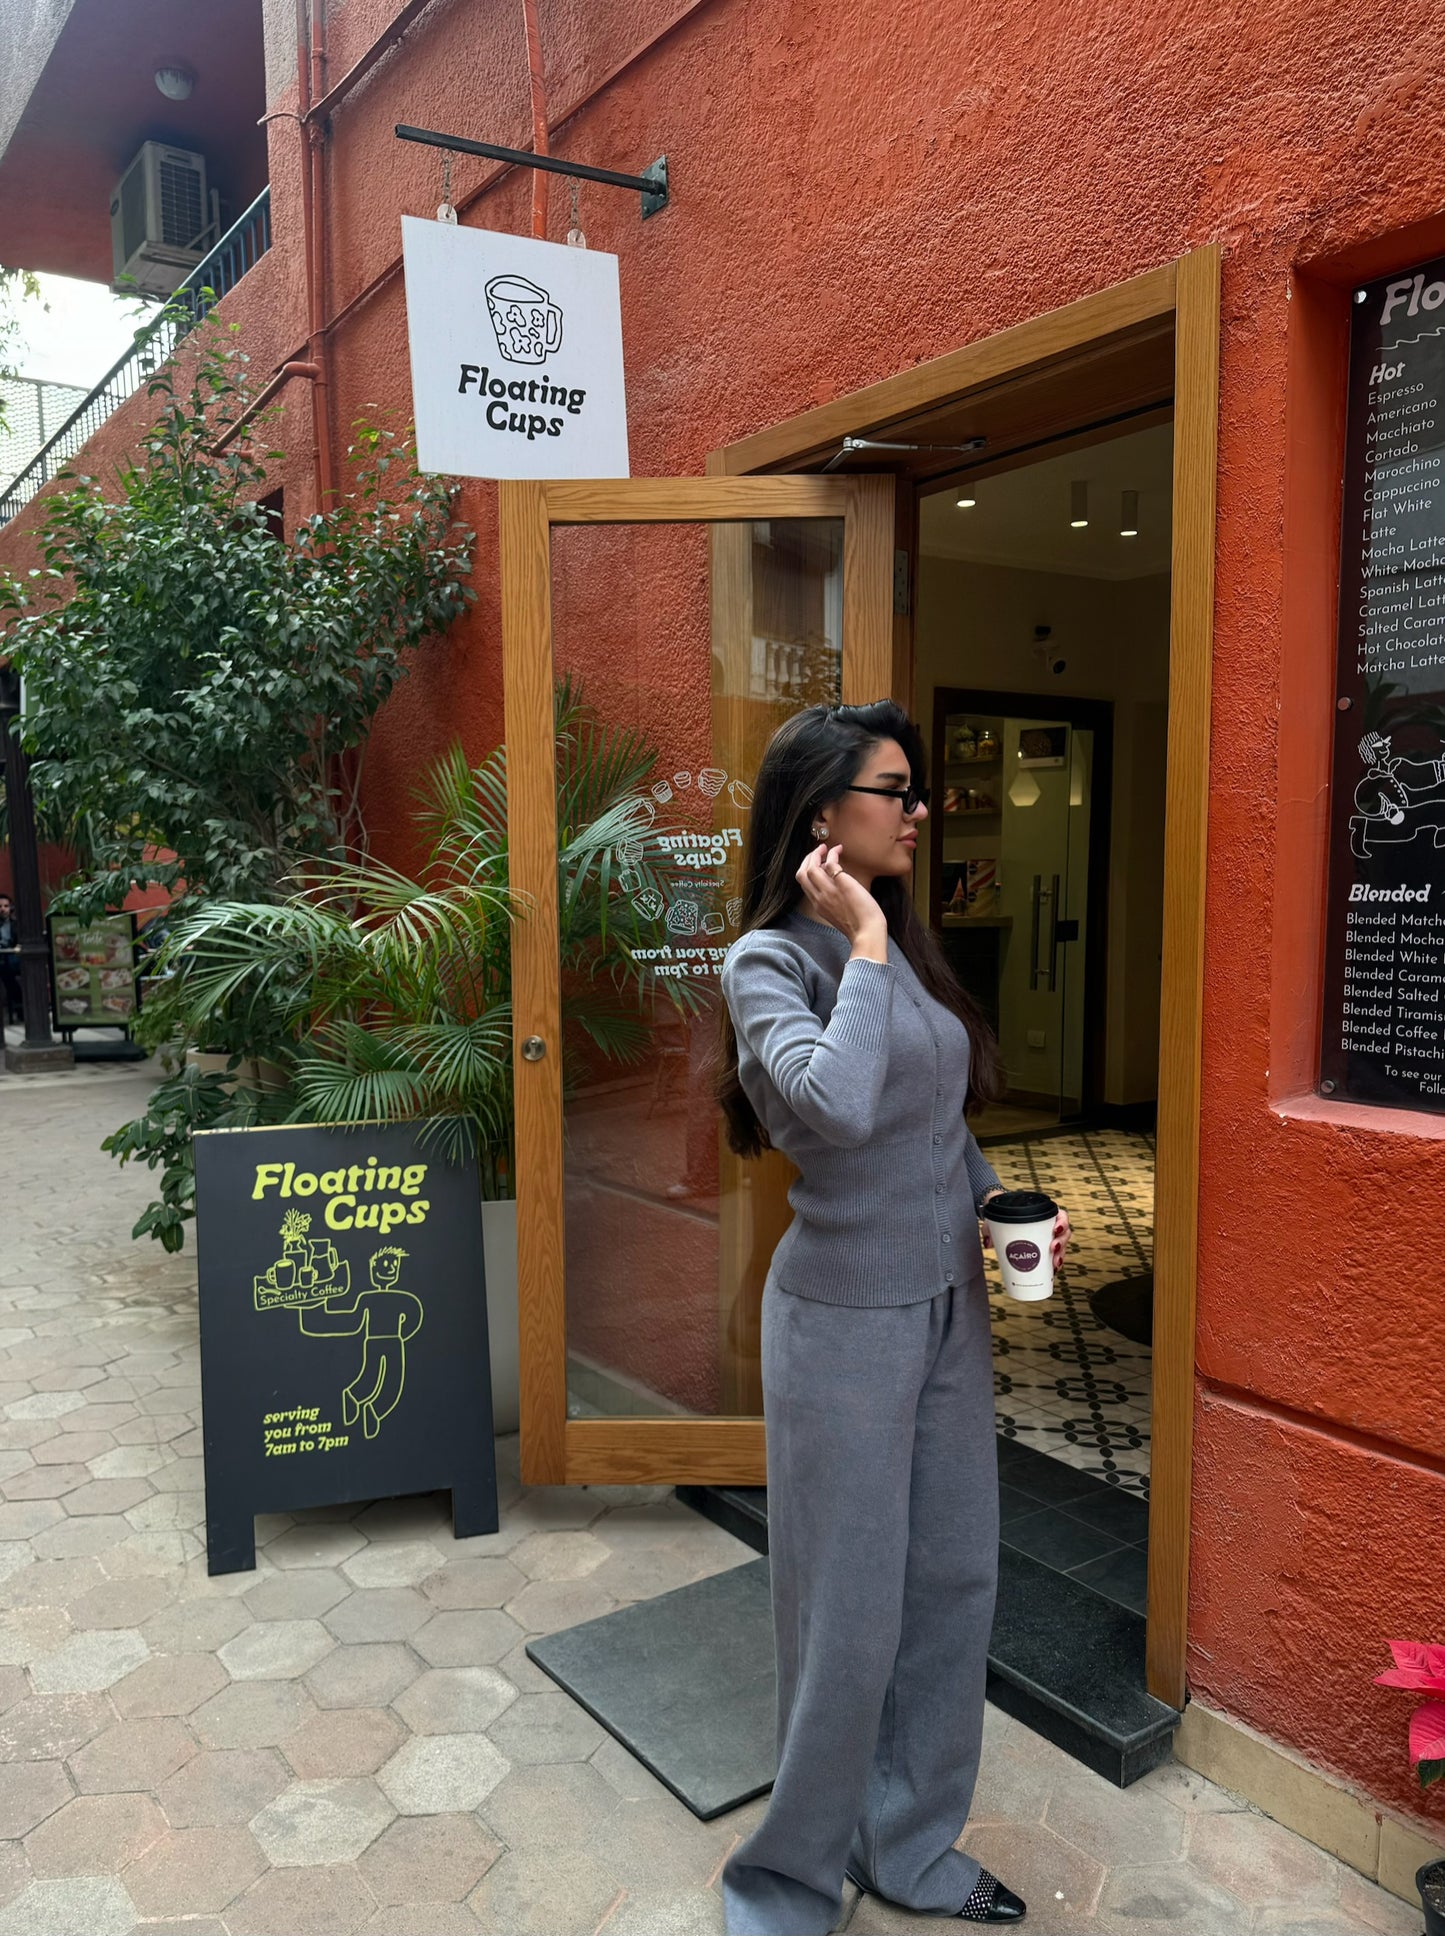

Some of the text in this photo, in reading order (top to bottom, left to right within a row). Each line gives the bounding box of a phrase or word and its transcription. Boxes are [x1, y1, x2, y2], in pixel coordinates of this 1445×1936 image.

[1368, 362, 1406, 386] Hot
[458, 364, 586, 414] Floating
[1367, 382, 1424, 406] Espresso
[486, 401, 564, 440] Cups
[1366, 399, 1437, 426] Americano
[1366, 418, 1435, 445] Macchiato
[1365, 440, 1419, 464] Cortado
[1364, 458, 1441, 484] Marocchino
[1363, 478, 1440, 502] Cappuccino
[1363, 499, 1432, 522] Flat White
[1362, 526, 1397, 541] Latte
[1361, 536, 1445, 561] Mocha Latte
[1361, 564, 1399, 579] White
[1360, 574, 1445, 601] Spanish Latt
[1359, 596, 1413, 617] Caramel
[1358, 618, 1399, 637] Salted
[1357, 633, 1445, 656] Hot Chocolat
[1357, 653, 1445, 675] Matcha Latte
[1348, 883, 1432, 903] Blended
[1346, 911, 1396, 926] Blended
[1345, 930, 1445, 946] Blended Mocha
[1345, 948, 1438, 964] Blended White
[1344, 966, 1394, 981] Blended
[1343, 984, 1439, 1002] Blended Salted
[1343, 1002, 1445, 1022] Blended Tiramis
[1342, 1020, 1438, 1040] Blended Coffee
[1341, 1038, 1390, 1054] Blended
[1384, 1065, 1442, 1081] To see our
[251, 1156, 428, 1200] Floating
[324, 1194, 430, 1234] Cups
[259, 1284, 344, 1306] Specialty Coffee
[263, 1405, 320, 1424] serving
[264, 1422, 332, 1443] you from
[265, 1435, 349, 1457] 7am to 7pm
